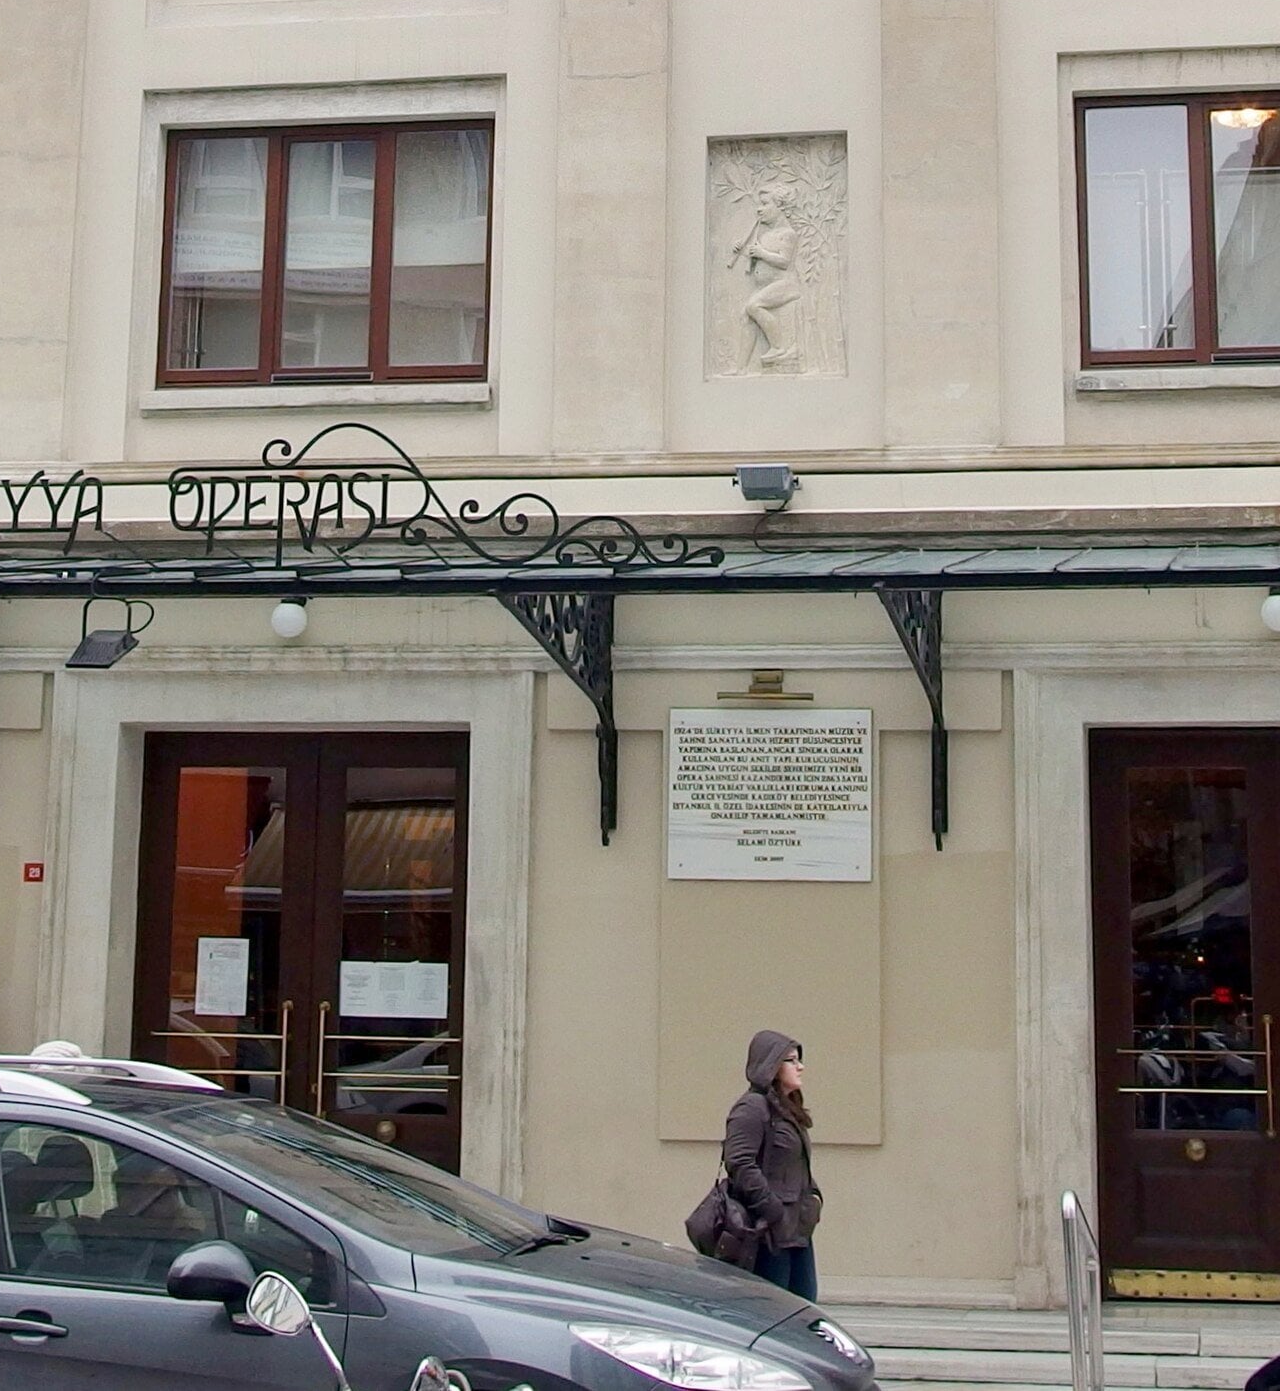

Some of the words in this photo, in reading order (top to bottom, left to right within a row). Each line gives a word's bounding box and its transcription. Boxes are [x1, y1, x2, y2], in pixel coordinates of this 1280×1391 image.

[169, 472, 393, 568] OPERASI
[773, 727, 827, 736] TARAFINDAN
[856, 727, 868, 736] VE
[679, 736, 706, 744] SAHNE
[708, 736, 767, 745] SANATLARINA
[830, 746, 864, 755] OLARAK
[682, 755, 735, 763] KULLANILAN
[795, 756, 859, 764] KURUCUSUNUN
[677, 774, 703, 782] OPERA
[706, 783, 715, 791] VE
[796, 784, 829, 792] KORUMA
[831, 784, 868, 792] KANUNU
[794, 803, 803, 811] DE
